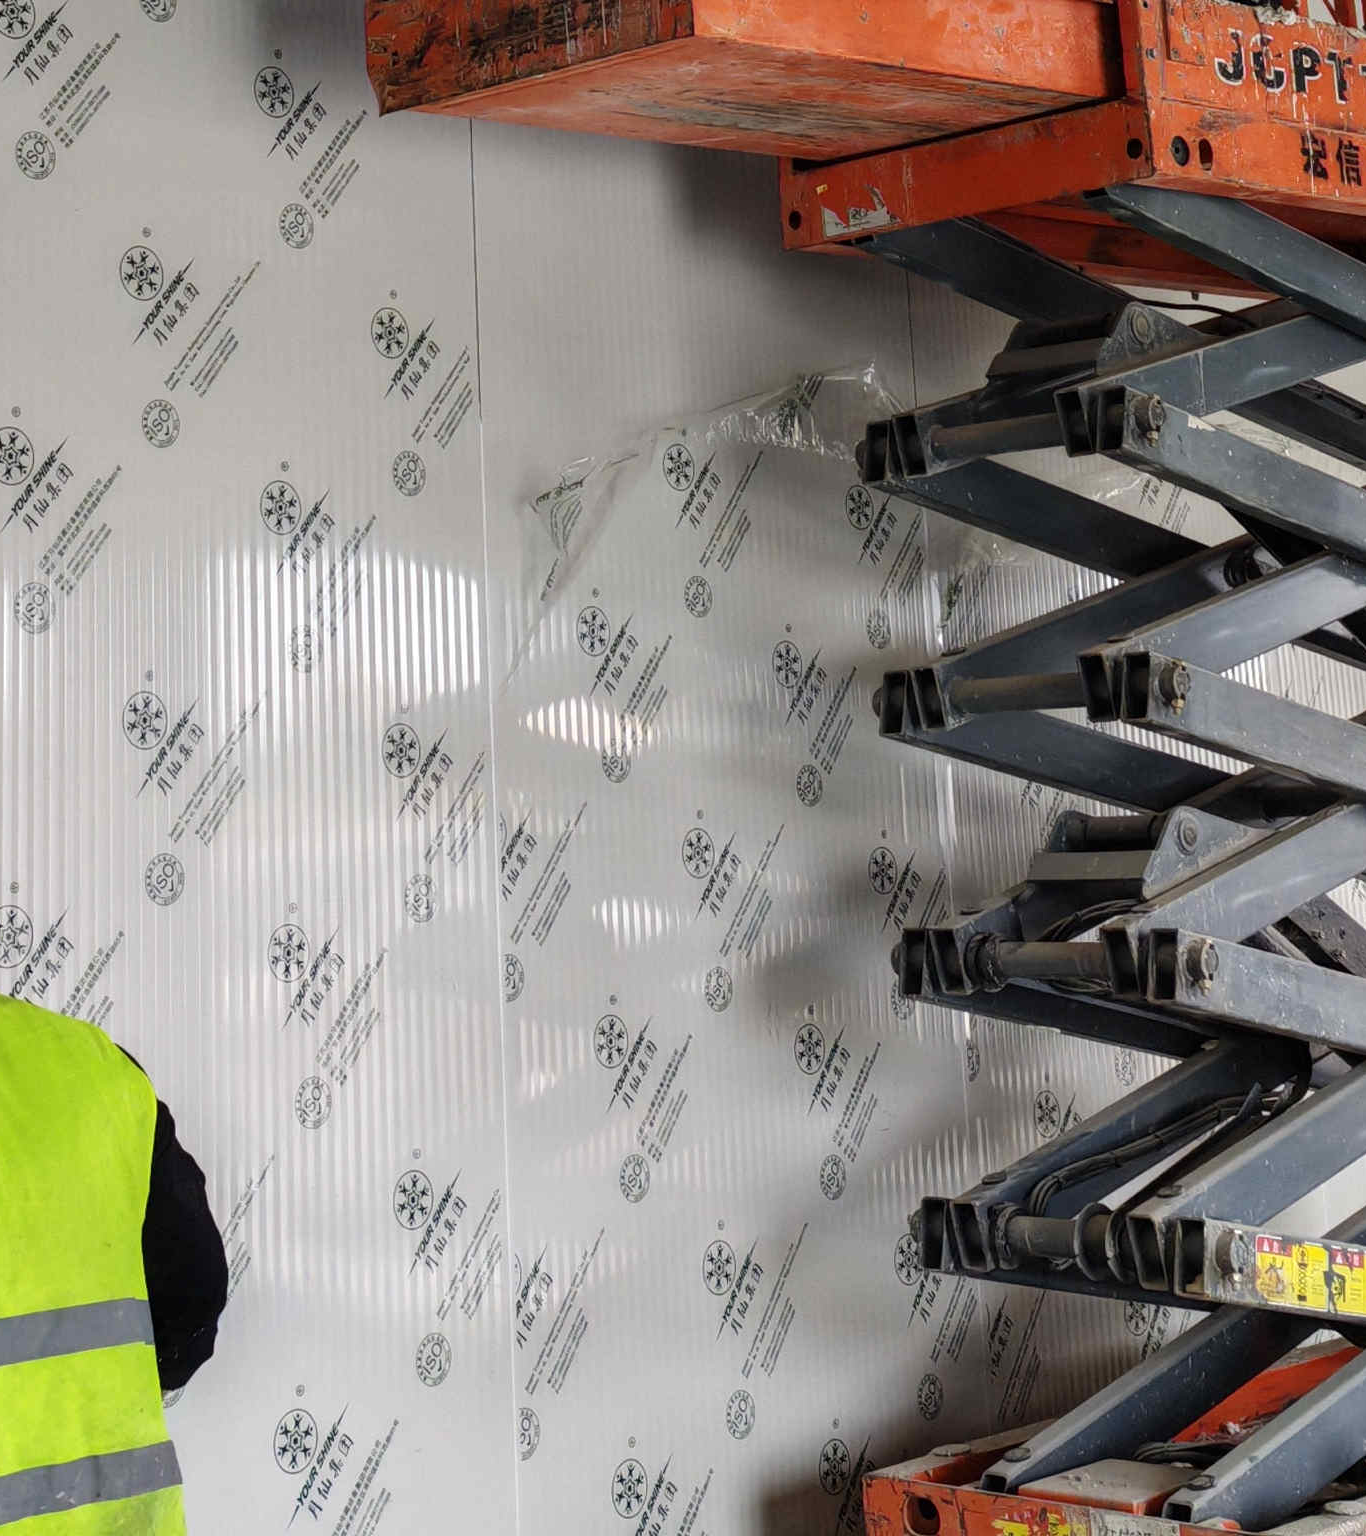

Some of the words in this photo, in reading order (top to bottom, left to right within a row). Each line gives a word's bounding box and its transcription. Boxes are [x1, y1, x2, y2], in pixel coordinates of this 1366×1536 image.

[12, 39, 35, 67] YOUR
[33, 11, 58, 44] SHINE
[21, 137, 47, 168] ISO
[142, 300, 163, 329] YOUR
[162, 270, 185, 304] SHINE
[147, 405, 171, 436] ISO
